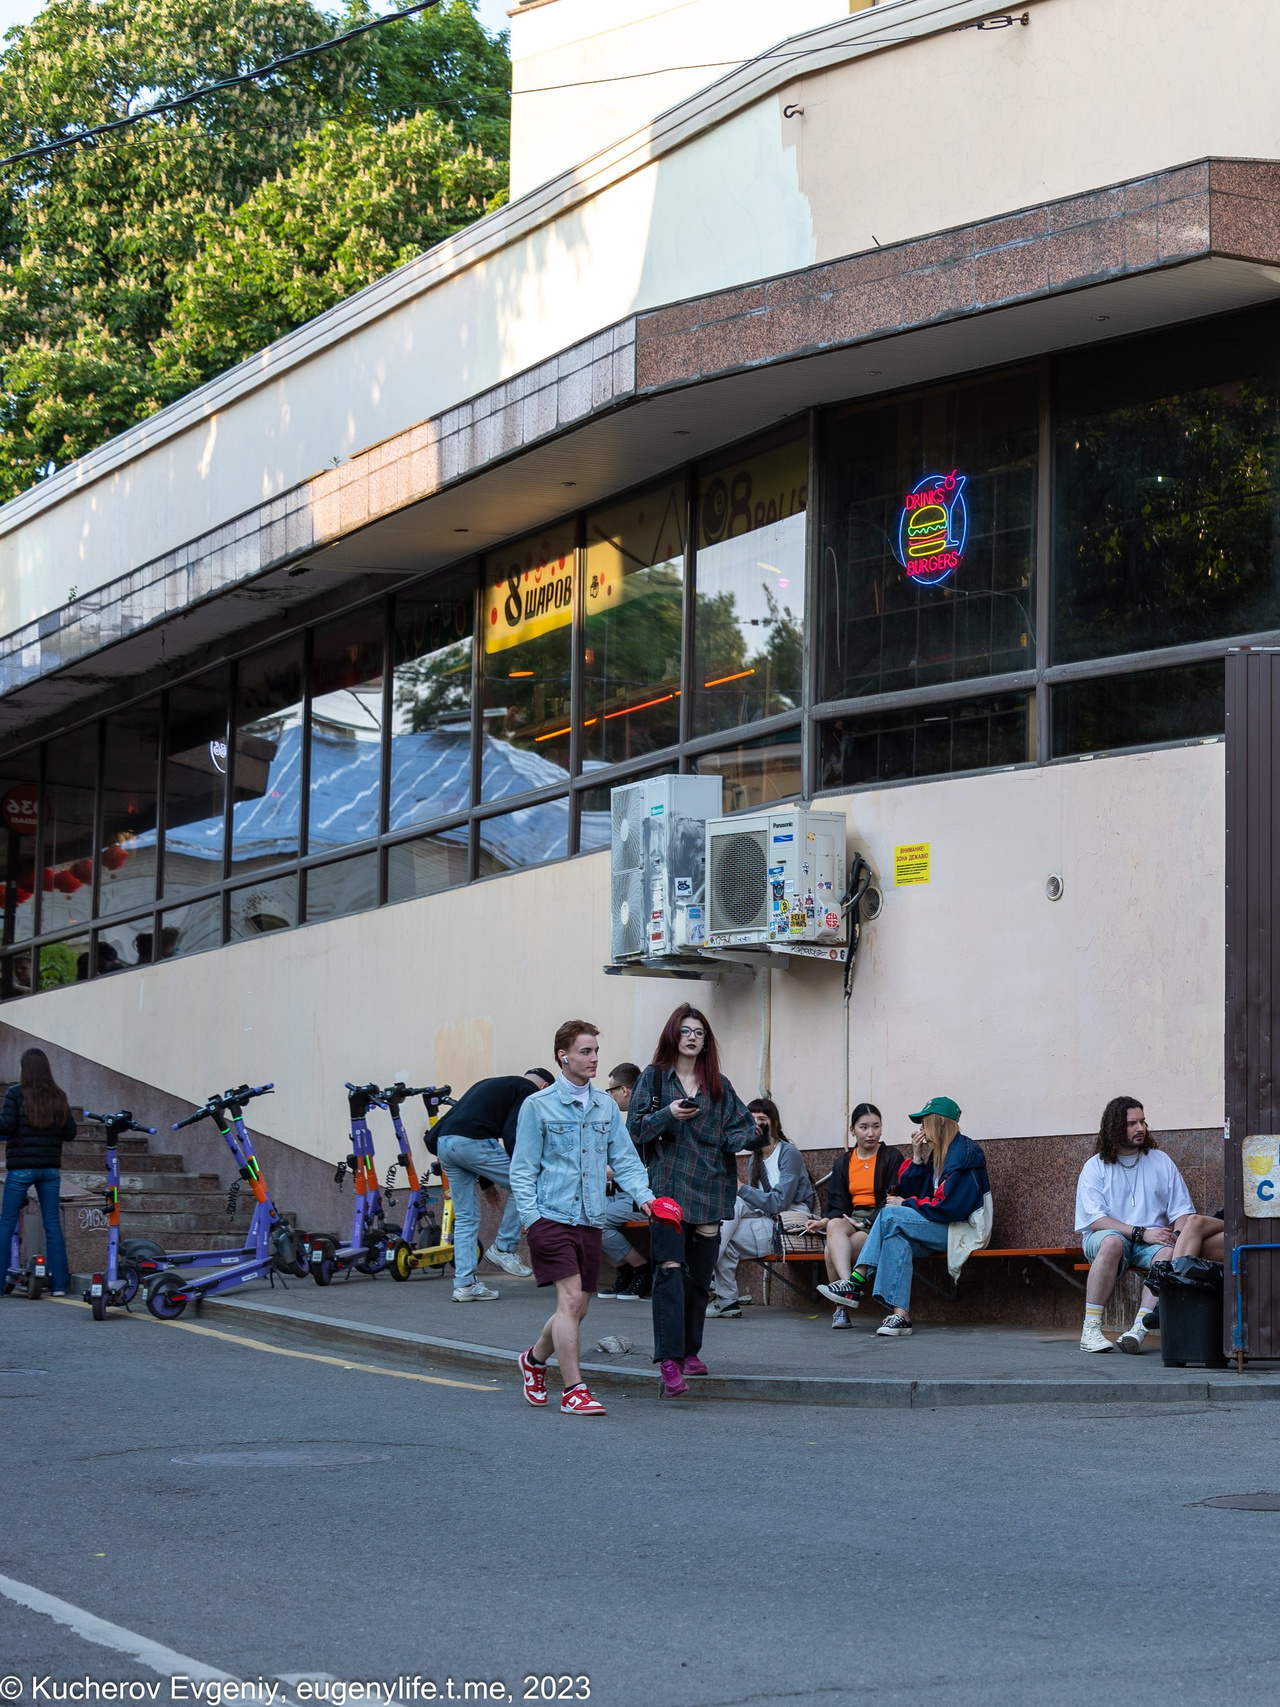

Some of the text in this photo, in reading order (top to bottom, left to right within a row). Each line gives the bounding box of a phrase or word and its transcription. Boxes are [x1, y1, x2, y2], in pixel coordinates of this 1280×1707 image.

[906, 487, 946, 511] DRINKS
[907, 551, 959, 577] BURGERS
[504, 563, 573, 627] 8 ШАРОВ
[772, 821, 794, 829] Panasonic
